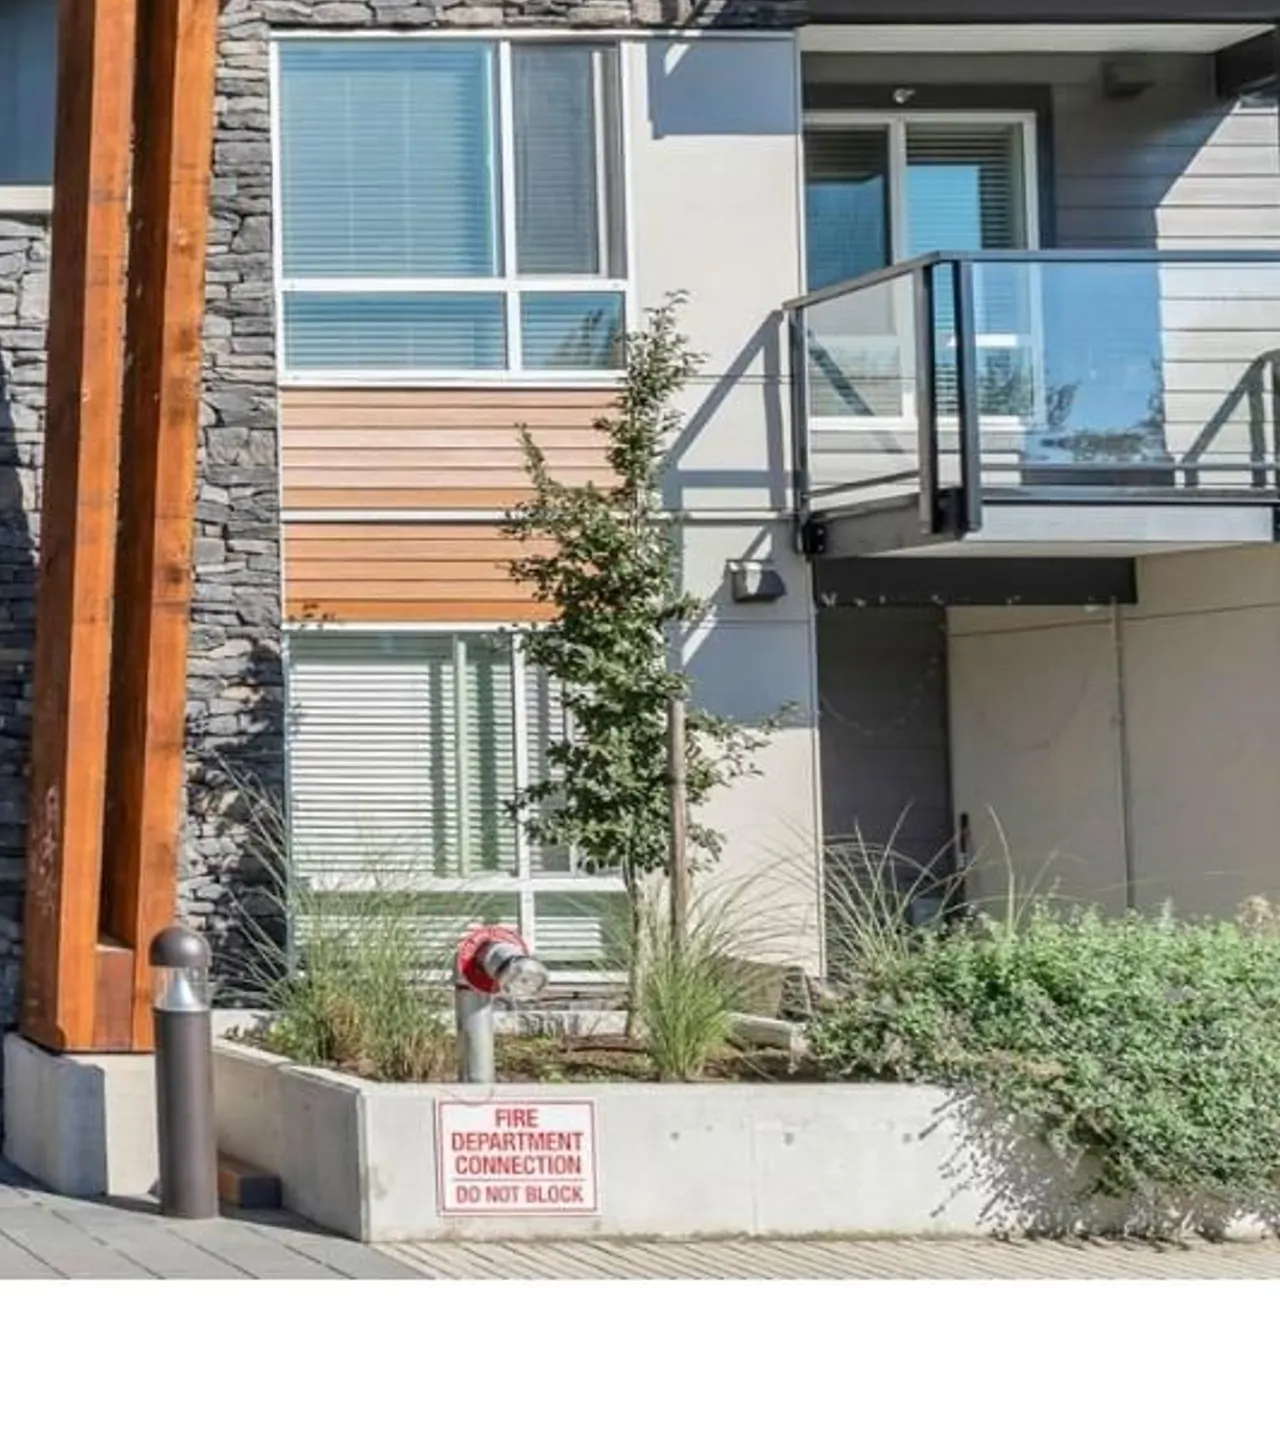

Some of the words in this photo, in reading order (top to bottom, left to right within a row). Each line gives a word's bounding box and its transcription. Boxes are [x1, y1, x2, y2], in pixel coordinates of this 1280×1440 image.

[495, 1108, 539, 1128] FIRE
[451, 1132, 584, 1151] DEPARTMENT
[454, 1155, 582, 1175] CONNECTION
[456, 1185, 481, 1204] DO
[485, 1185, 520, 1203] NOT
[525, 1185, 585, 1203] BLOCK
